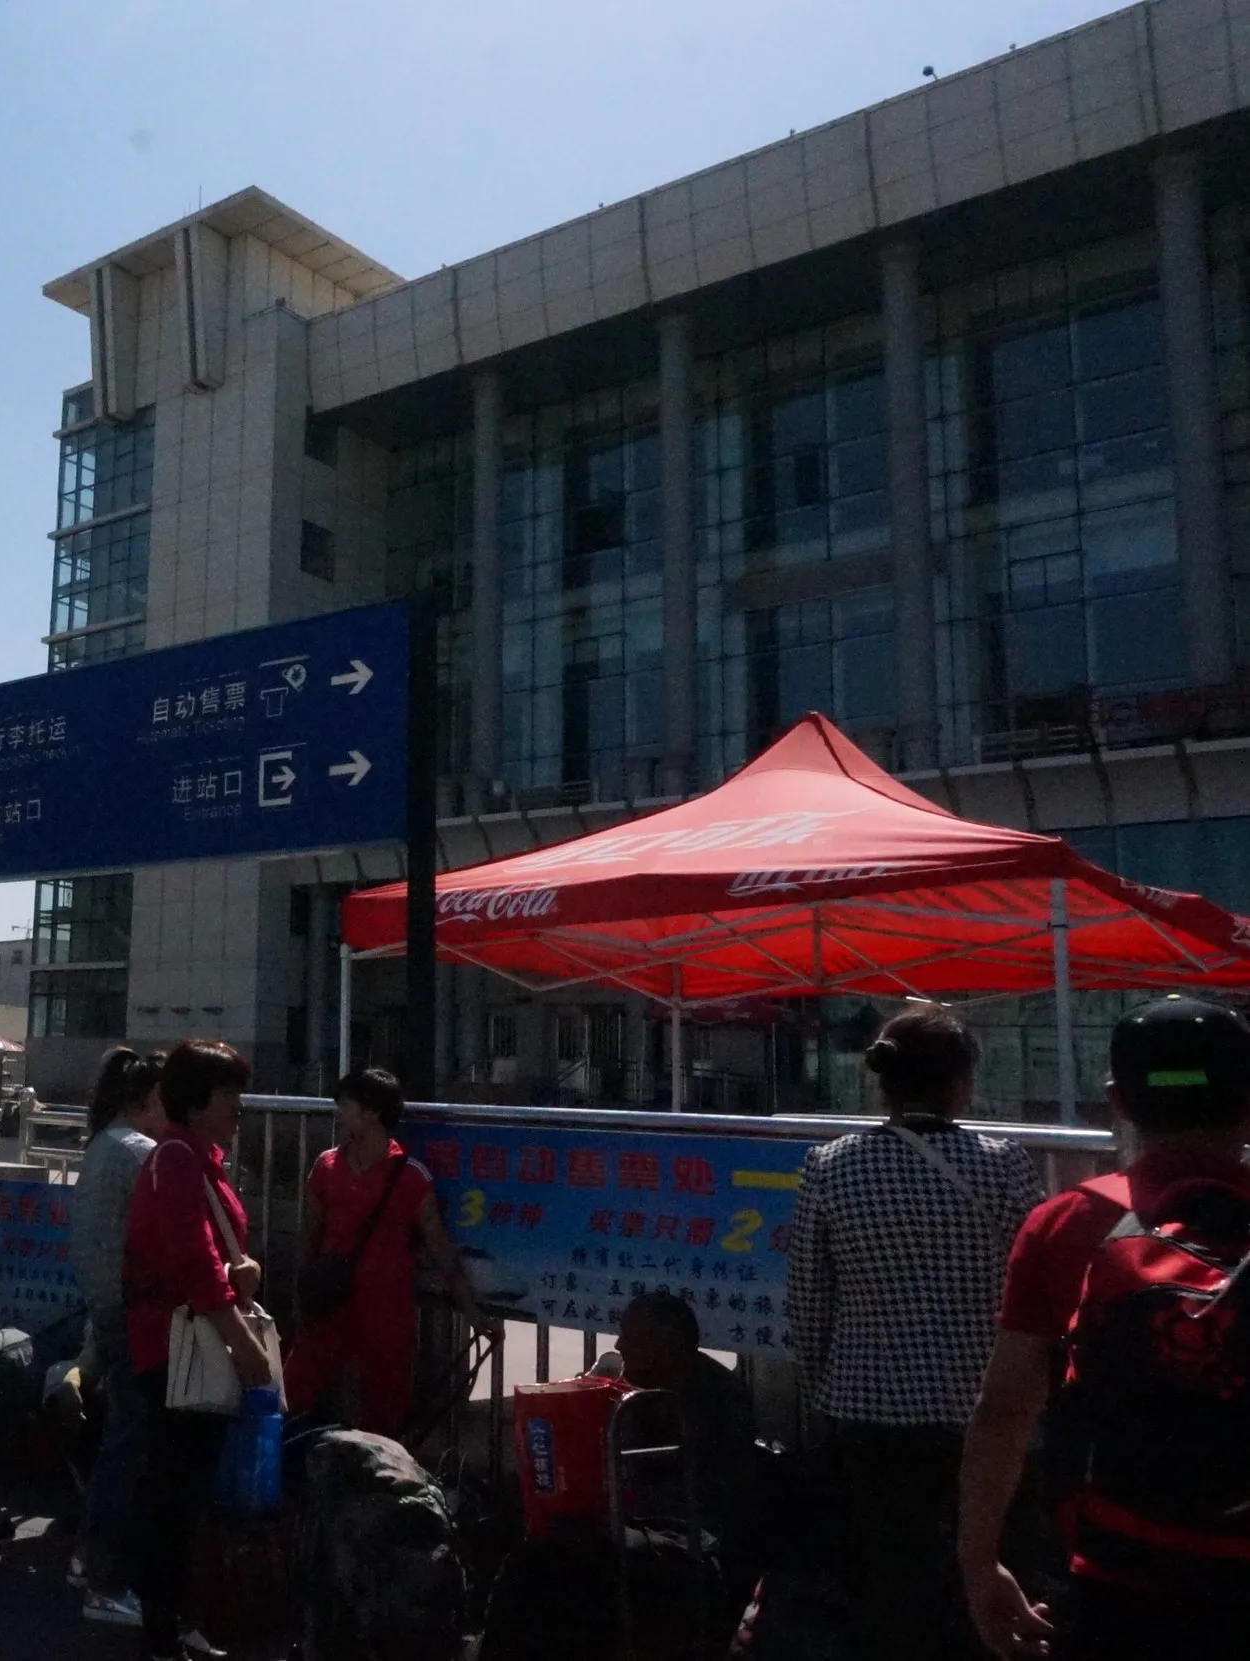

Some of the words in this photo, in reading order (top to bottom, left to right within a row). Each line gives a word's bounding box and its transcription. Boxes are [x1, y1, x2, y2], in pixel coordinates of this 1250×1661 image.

[152, 680, 247, 725] 自动售票
[171, 769, 242, 804] 进站口
